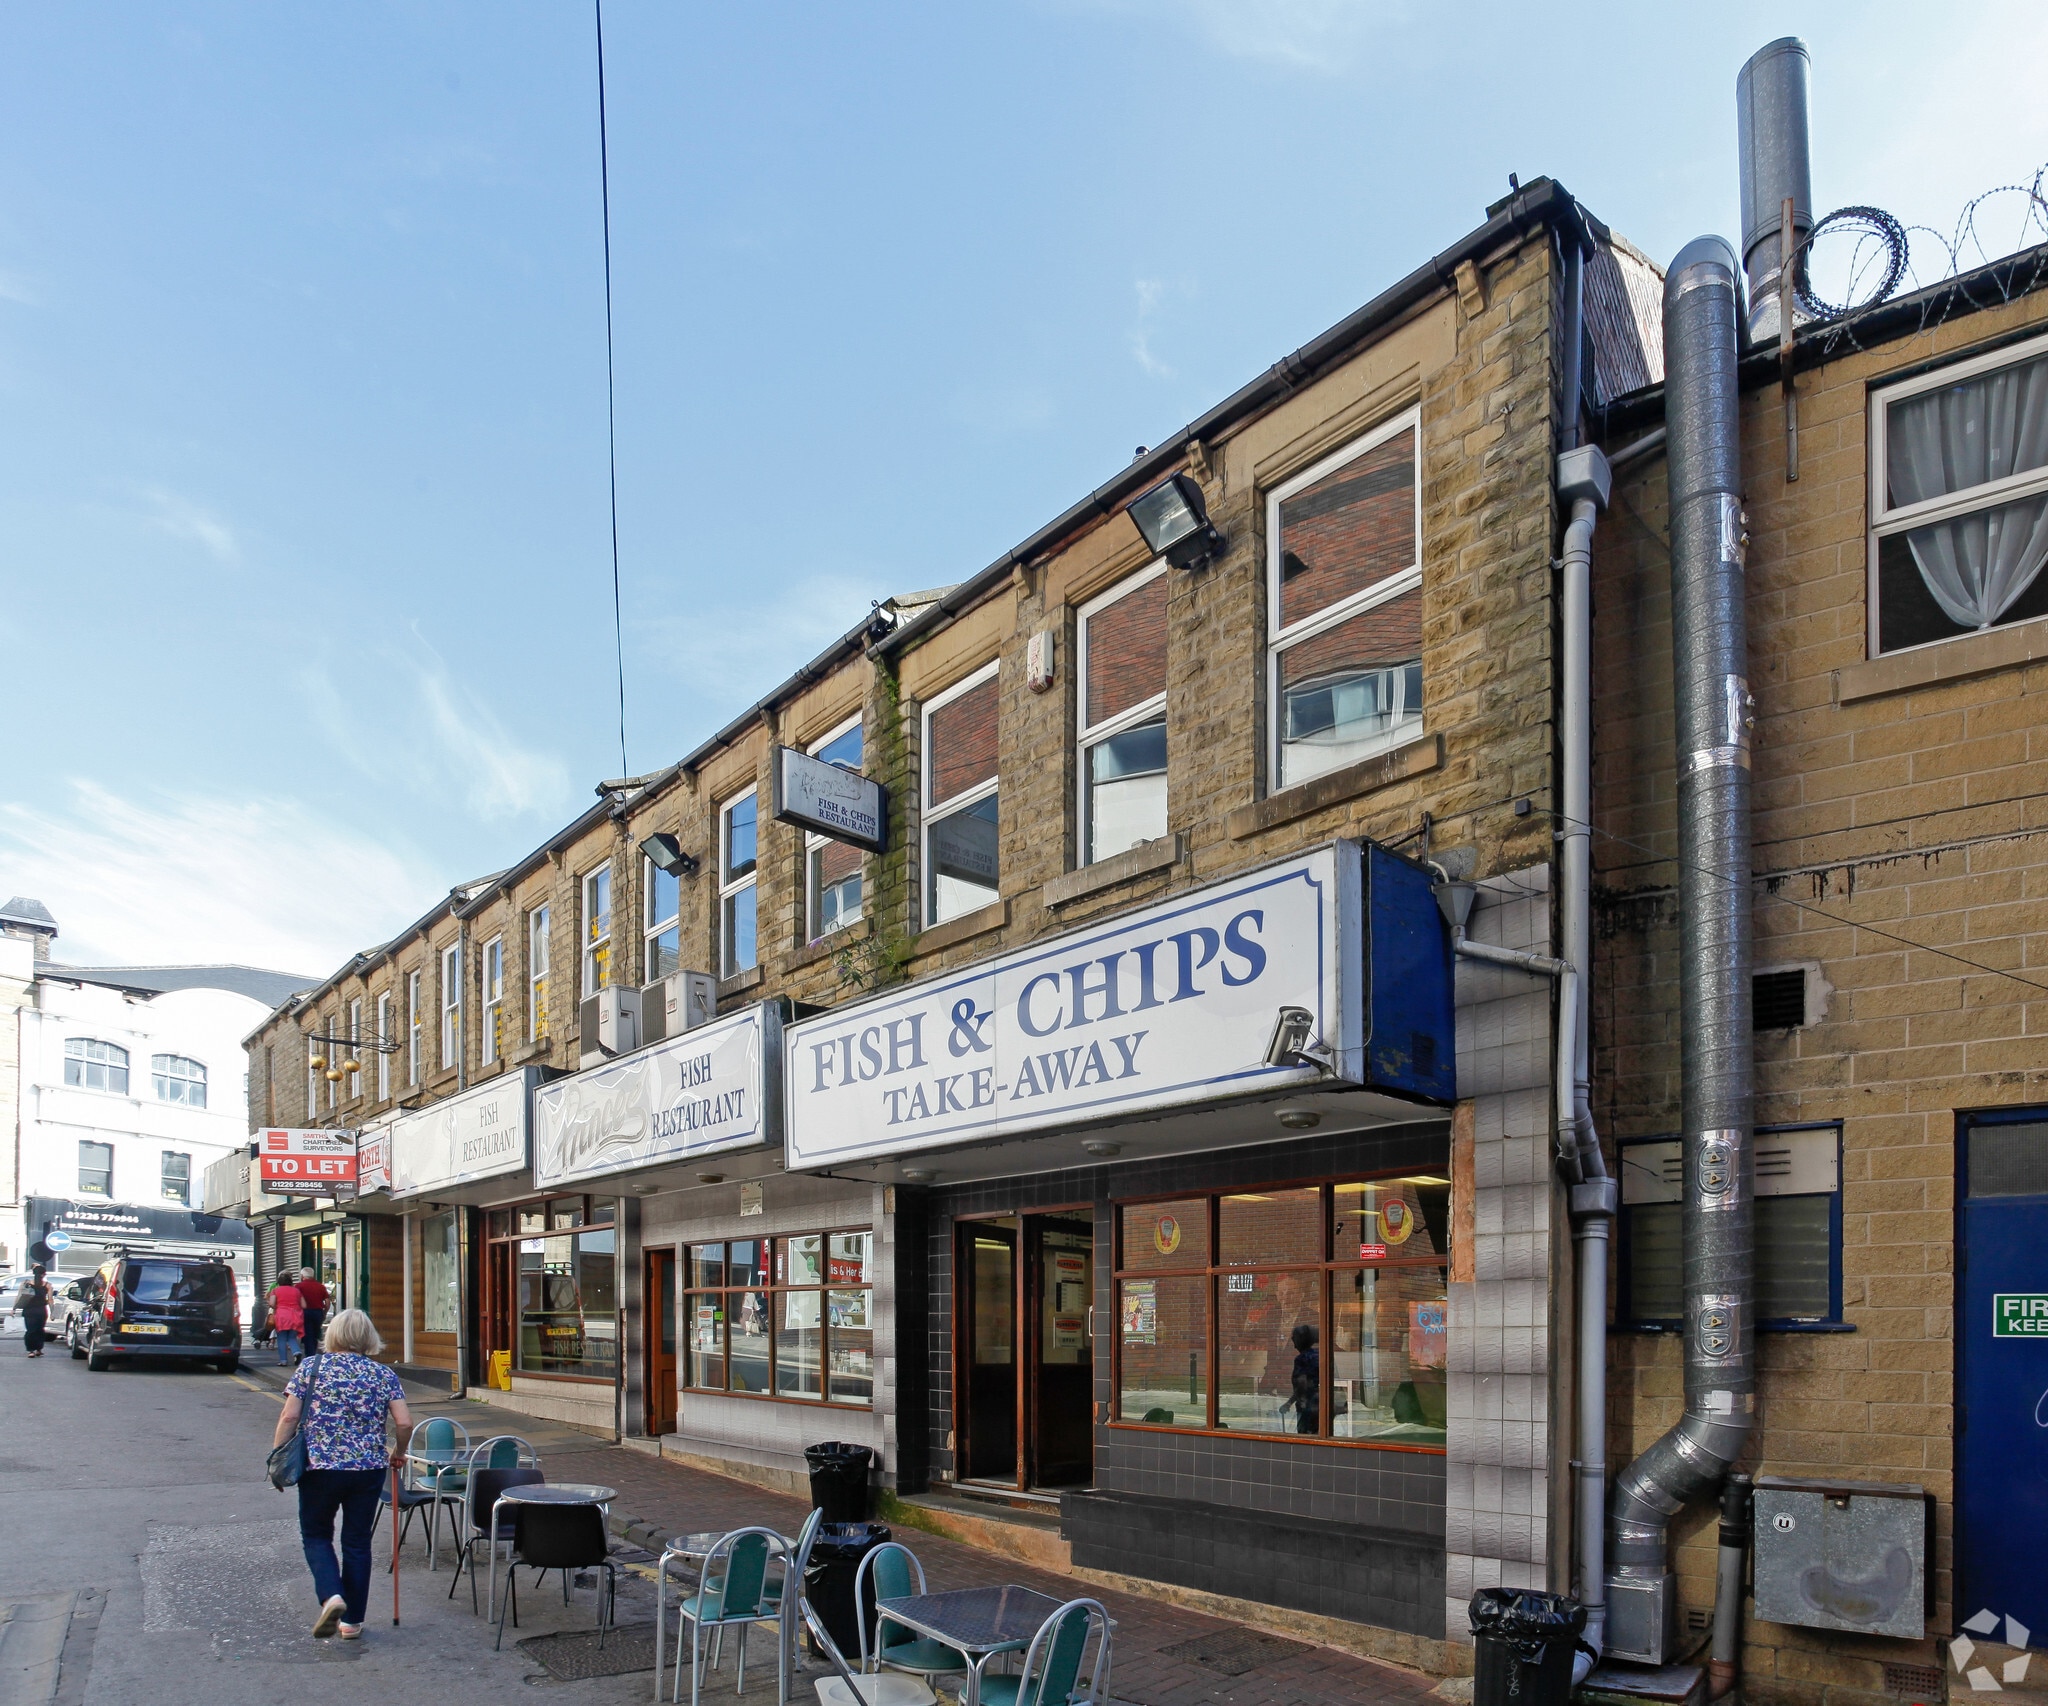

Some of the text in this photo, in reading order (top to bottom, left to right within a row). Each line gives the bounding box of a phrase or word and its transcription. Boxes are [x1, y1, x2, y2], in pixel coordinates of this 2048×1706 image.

[818, 797, 876, 826] FISH & CHIPS
[818, 808, 876, 836] RESTAURANT
[809, 909, 1267, 1093] FISH & CHIPS
[680, 1052, 712, 1090] FISH
[882, 1030, 1150, 1126] TAKE-AWAY
[480, 1101, 499, 1128] FISH
[651, 1088, 745, 1140] RESTAURANT
[463, 1126, 517, 1163] RESTAURANT
[266, 1158, 349, 1175] TO LET
[65, 1211, 100, 1221] 01226
